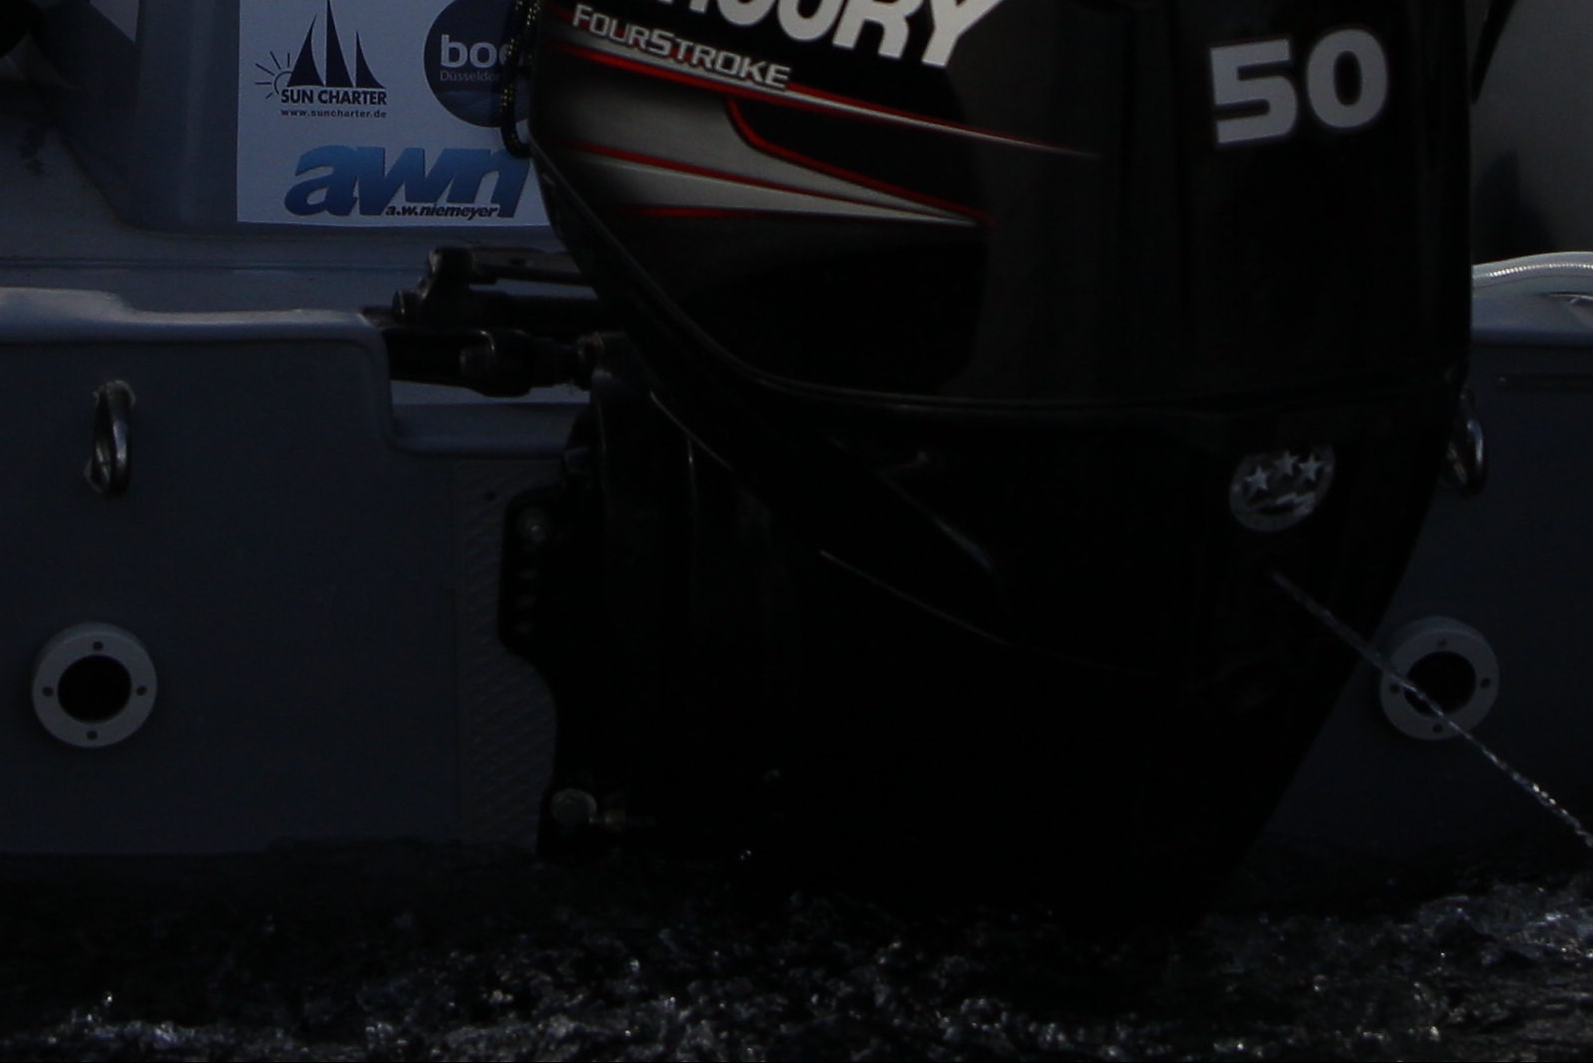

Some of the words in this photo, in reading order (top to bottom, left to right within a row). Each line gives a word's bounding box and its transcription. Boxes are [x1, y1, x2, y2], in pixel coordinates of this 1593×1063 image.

[571, 3, 792, 91] FOURSTROKE
[1210, 28, 1389, 146] 50
[281, 89, 314, 105] SUN
[318, 90, 387, 106] CHARTER
[284, 144, 530, 217] awn
